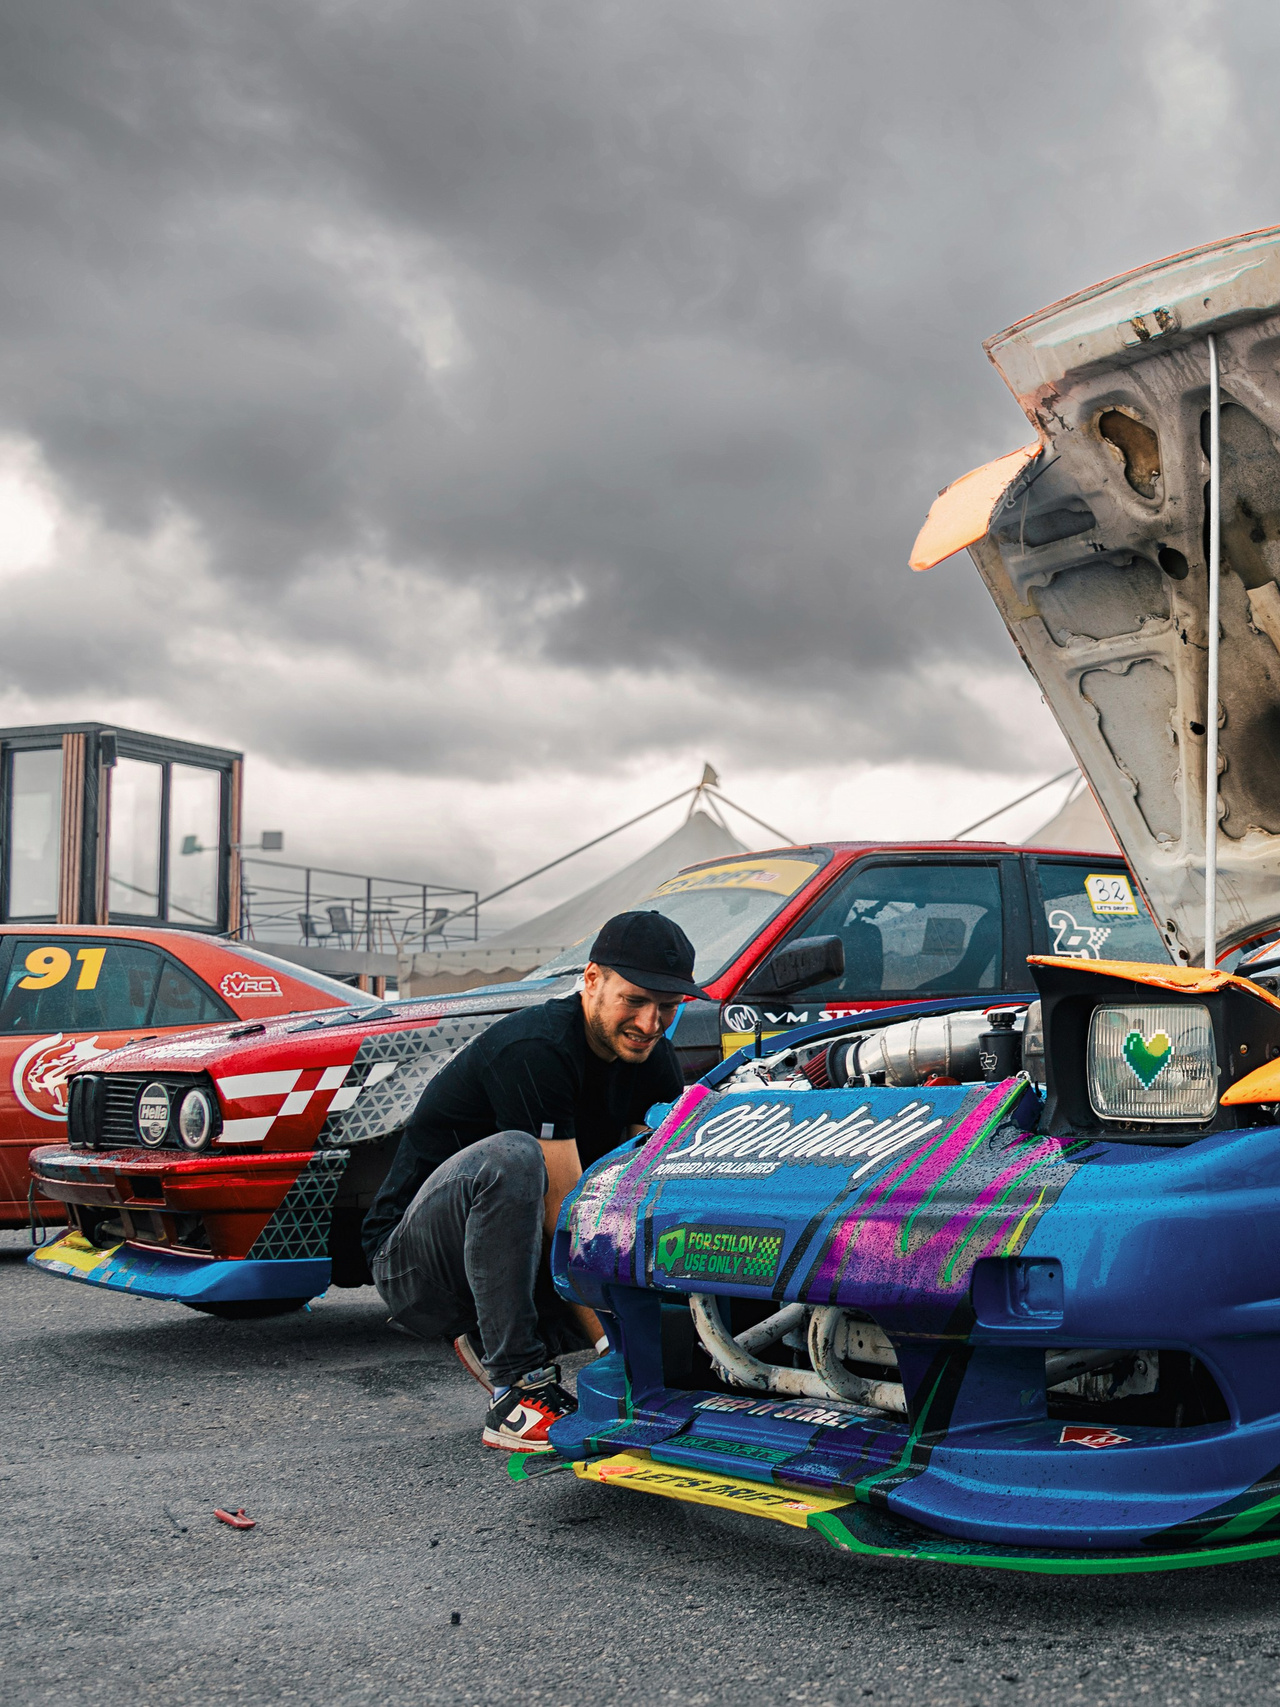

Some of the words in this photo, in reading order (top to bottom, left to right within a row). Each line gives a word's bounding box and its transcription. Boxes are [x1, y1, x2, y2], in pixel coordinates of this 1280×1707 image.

[1096, 879, 1125, 901] 32
[18, 946, 107, 991] 91
[230, 980, 273, 992] VRC
[764, 1011, 808, 1023] VM
[141, 1105, 168, 1119] Hella
[650, 1162, 700, 1175] POWERED
[696, 1162, 720, 1174] BY
[711, 1161, 781, 1174] FOLLOWERS
[688, 1232, 712, 1250] FOR
[713, 1233, 758, 1253] STILOV
[684, 1253, 707, 1272] USE
[707, 1255, 743, 1274] ONLY
[692, 1396, 758, 1413] KEEP
[747, 1402, 785, 1416] IT
[773, 1404, 868, 1429] STREET
[618, 1469, 704, 1488] LET'S
[699, 1483, 805, 1506] DRIFT
